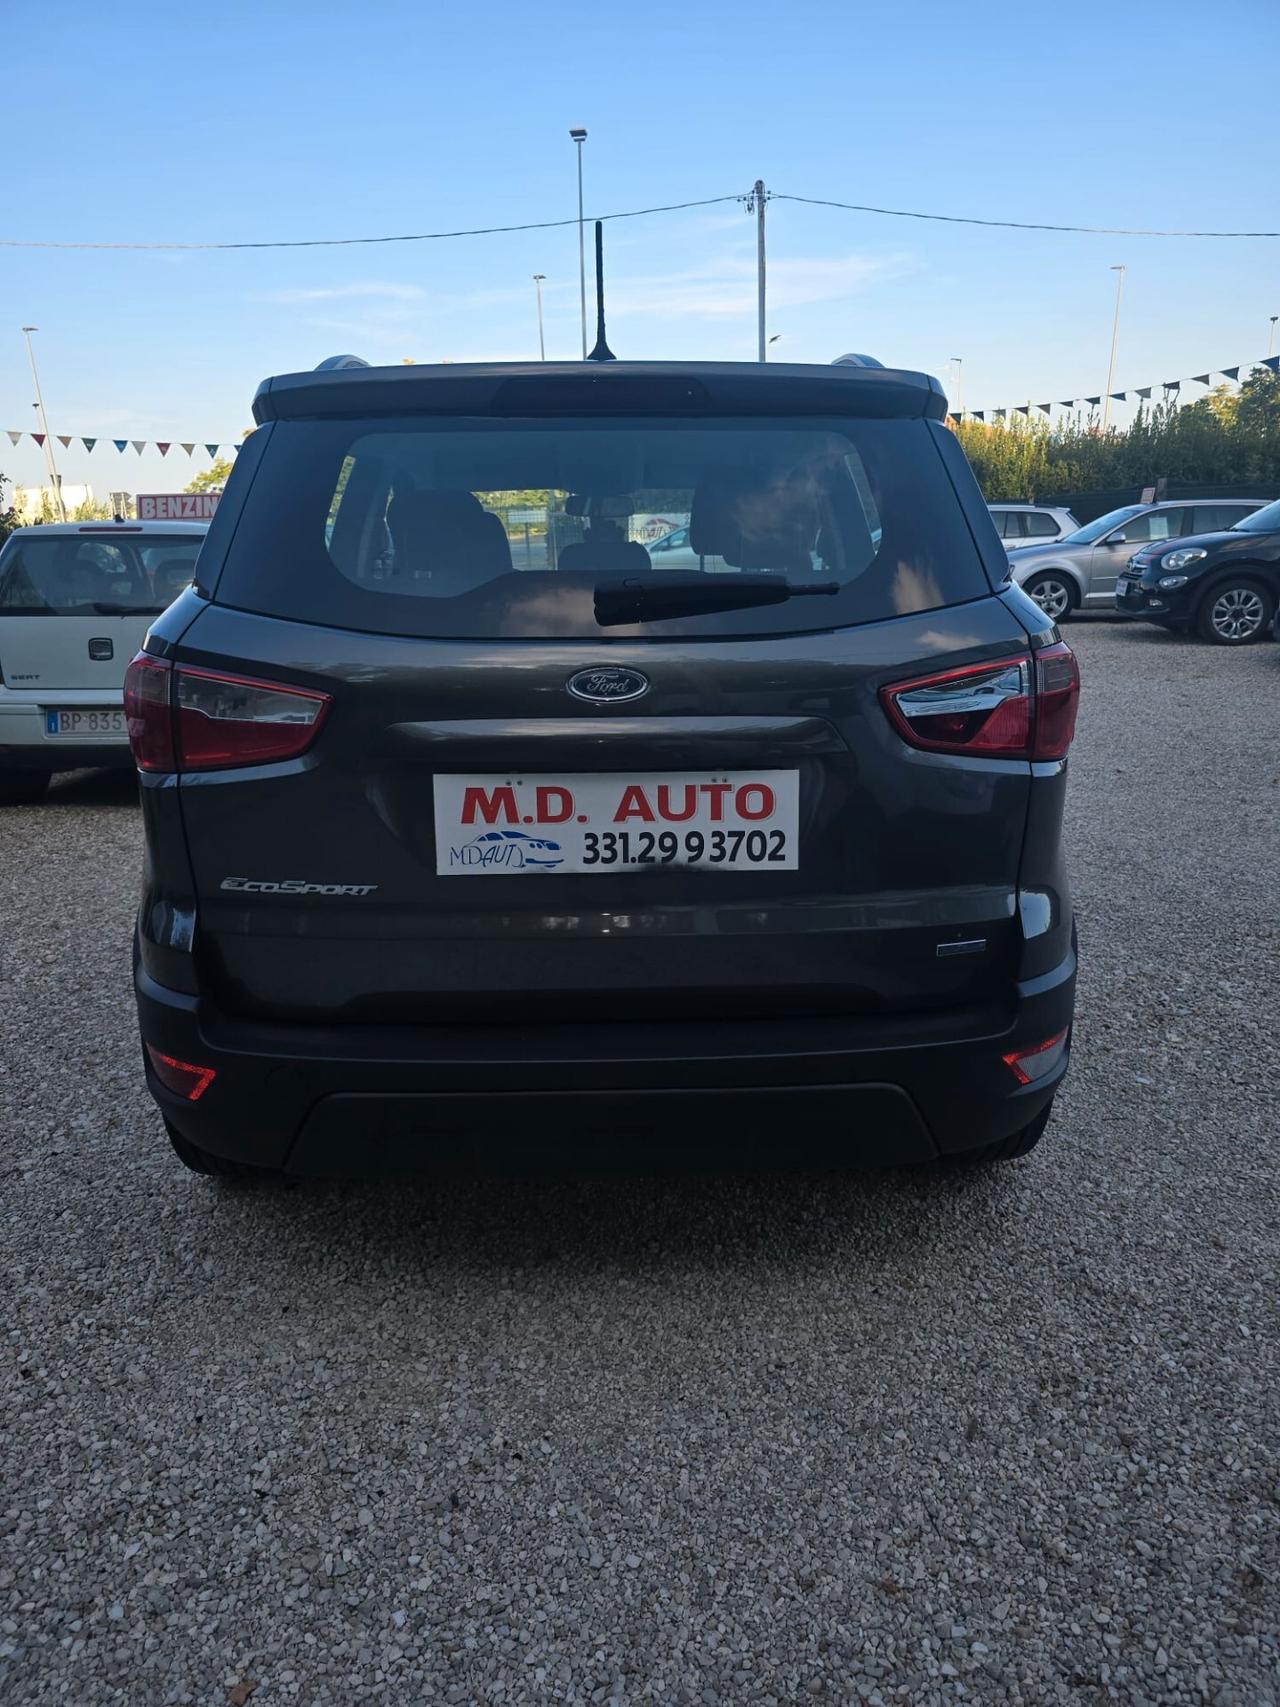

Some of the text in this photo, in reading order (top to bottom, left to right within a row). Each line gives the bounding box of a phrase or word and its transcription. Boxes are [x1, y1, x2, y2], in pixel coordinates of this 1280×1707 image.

[586, 673, 630, 693] Ford
[460, 783, 777, 825] M.D. AUTO
